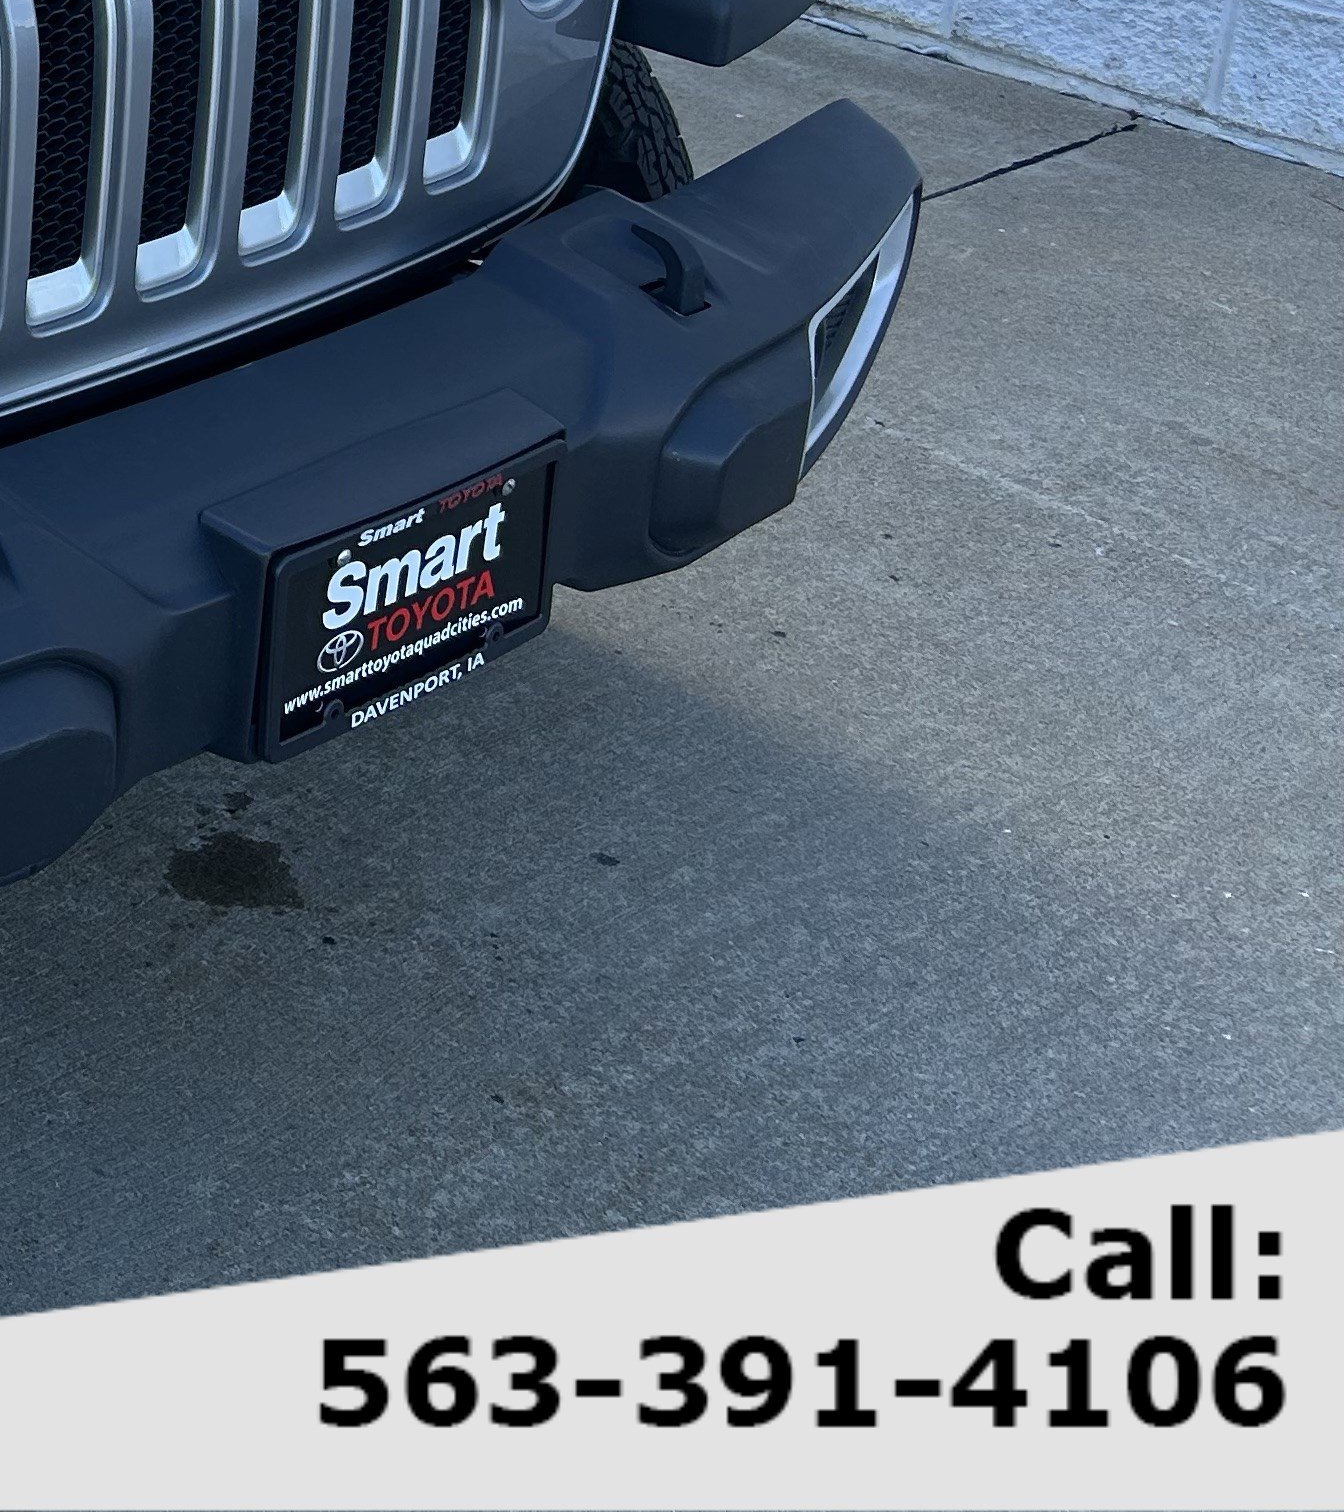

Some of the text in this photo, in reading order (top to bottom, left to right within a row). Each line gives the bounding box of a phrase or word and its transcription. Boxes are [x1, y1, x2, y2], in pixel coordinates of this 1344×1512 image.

[322, 502, 506, 630] Smart
[358, 507, 426, 548] Smart
[367, 569, 496, 651] TOYOTA
[284, 595, 524, 715] www.smarttoyotaquadcities.com
[350, 652, 485, 728] DAVENPORT, IA
